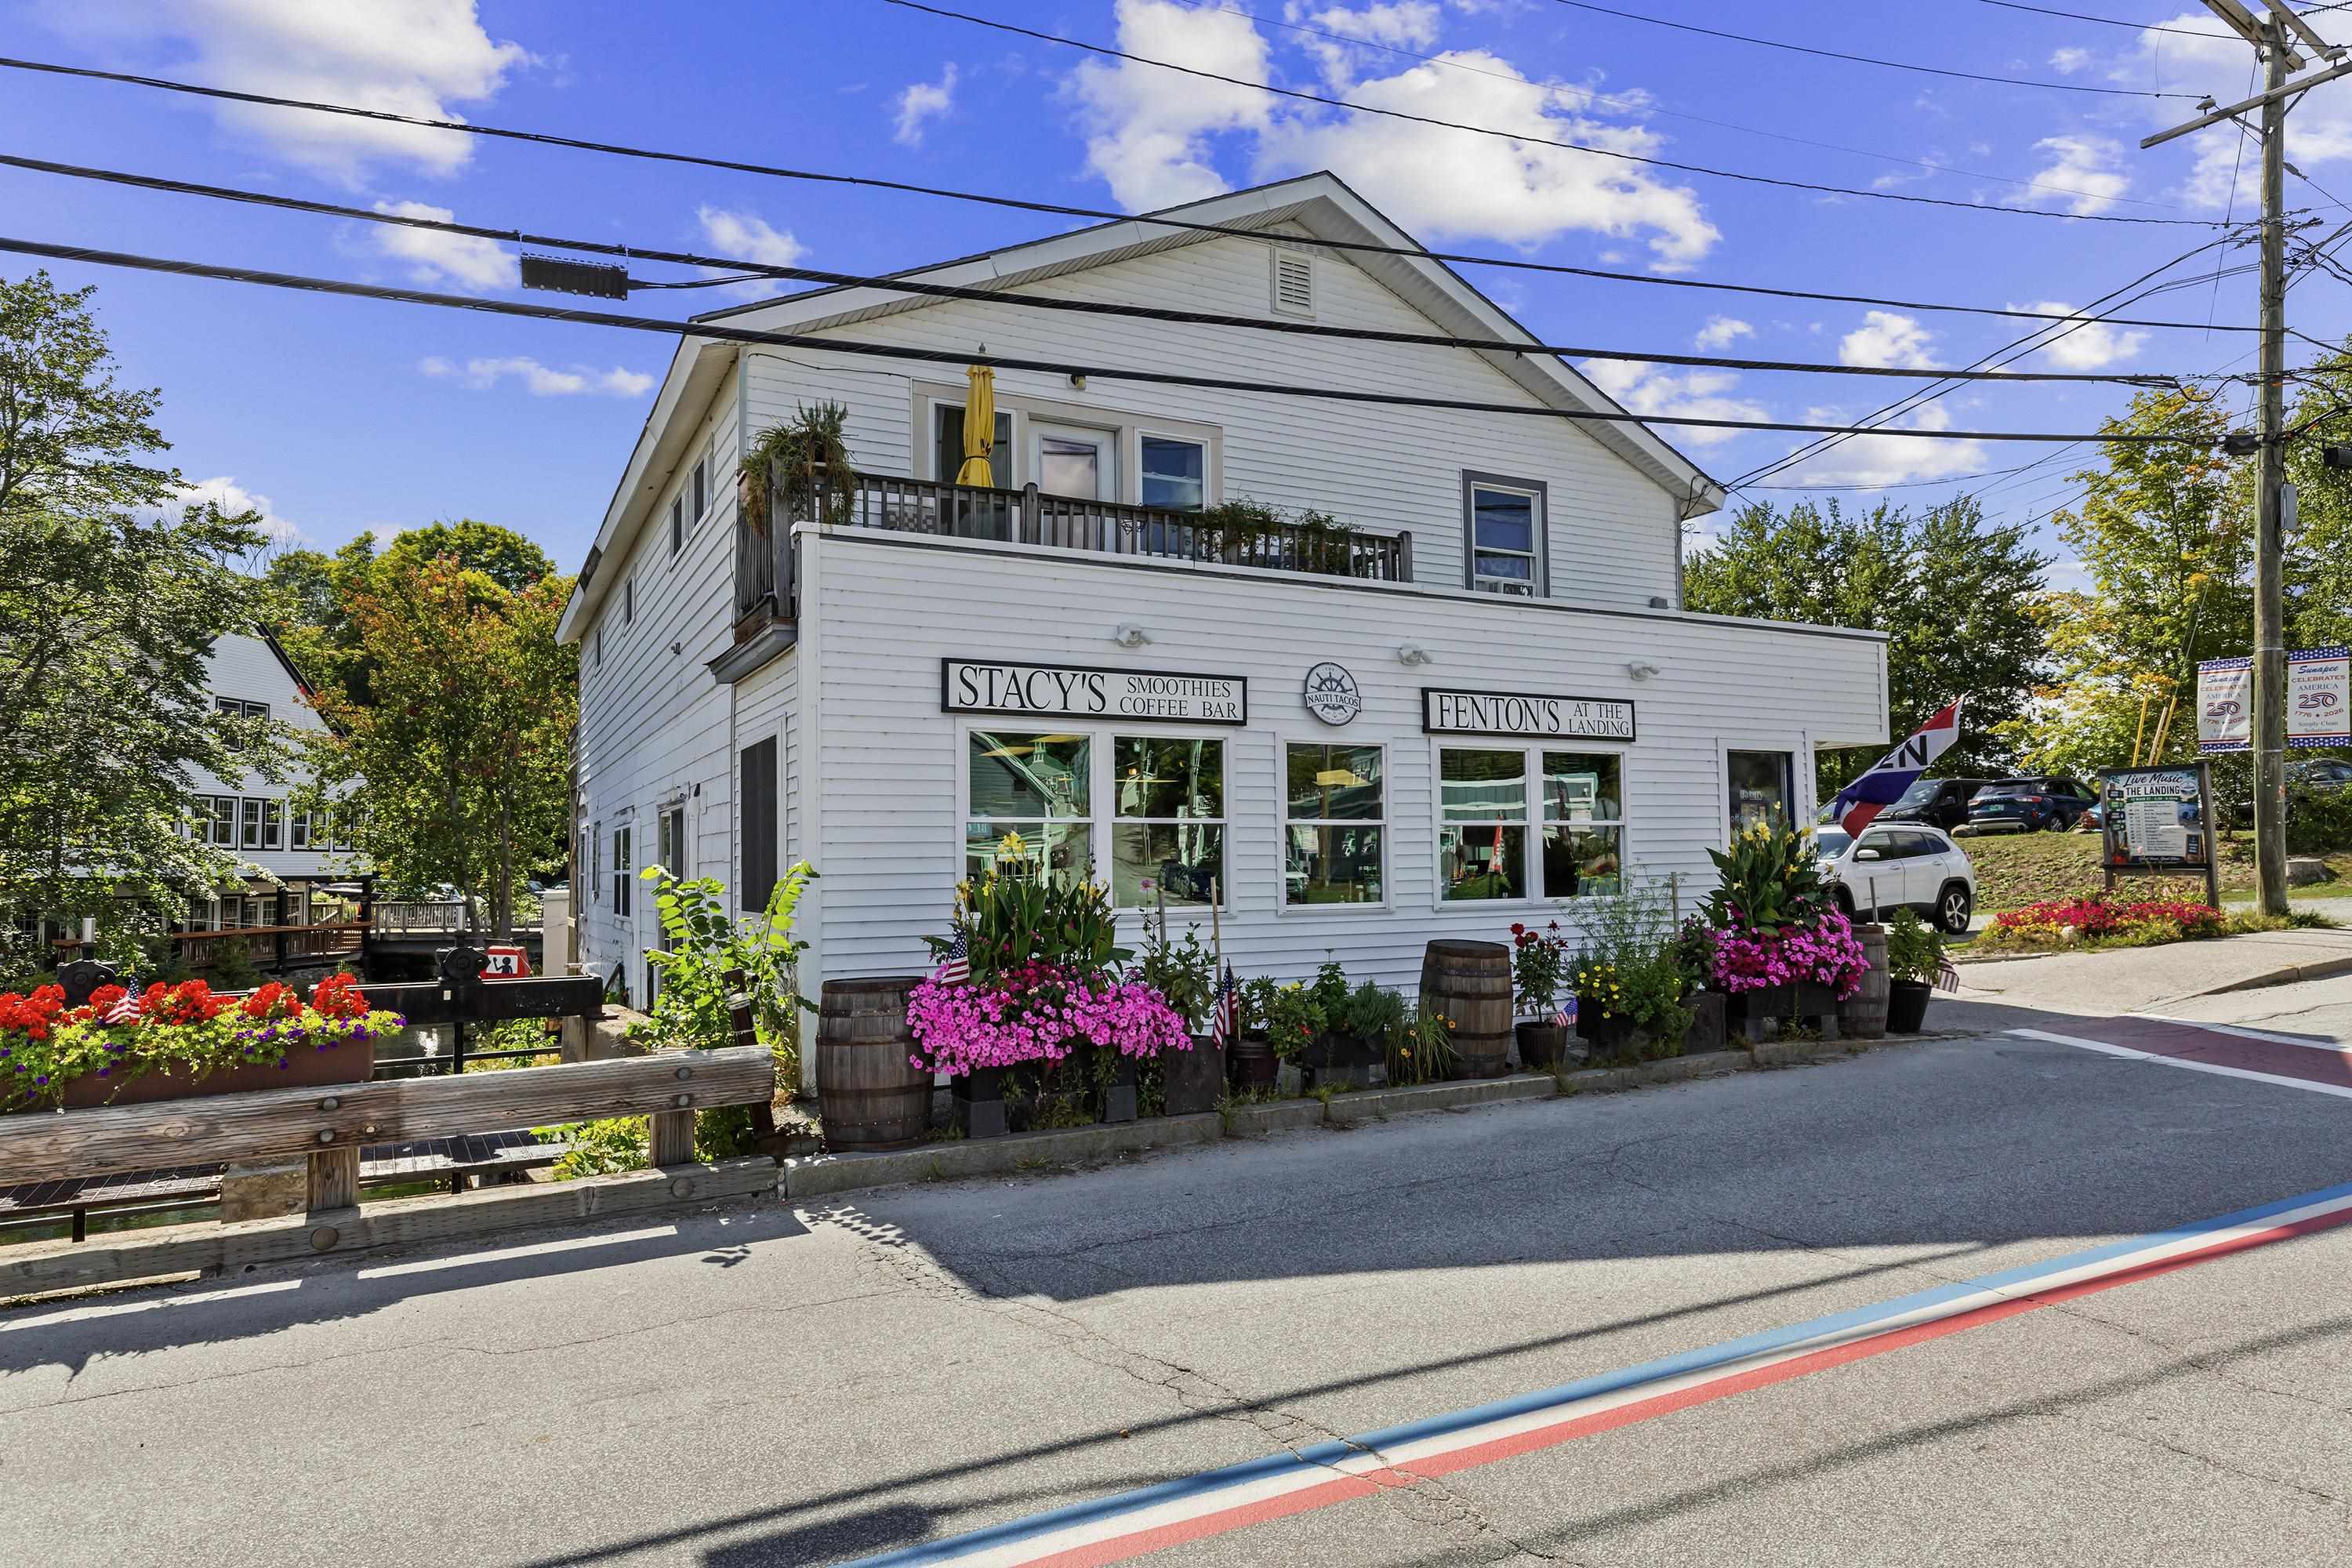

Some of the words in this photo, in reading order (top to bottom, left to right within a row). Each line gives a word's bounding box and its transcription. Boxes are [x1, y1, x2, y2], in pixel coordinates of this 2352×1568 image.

[2298, 665, 2339, 674] Sunapee
[2291, 674, 2347, 683] CELEBRATES
[958, 665, 1106, 713] STACY'S
[1127, 677, 1231, 698] SMOOTHIES
[1119, 696, 1189, 717] COFFEE
[1202, 702, 1238, 718] BAR
[1307, 694, 1333, 704] NAUTI
[1334, 694, 1359, 707] TACOS
[2298, 691, 2338, 709] 250
[1437, 694, 1560, 734] FENTON'S
[1573, 702, 1590, 718] AT
[1596, 703, 1623, 720] THE
[2324, 707, 2344, 717] 2026
[1569, 719, 1630, 736] LANDING
[2123, 775, 2147, 787] Live
[2149, 773, 2183, 783] Music
[2125, 786, 2142, 796] THE
[2144, 786, 2180, 795] LANDING
